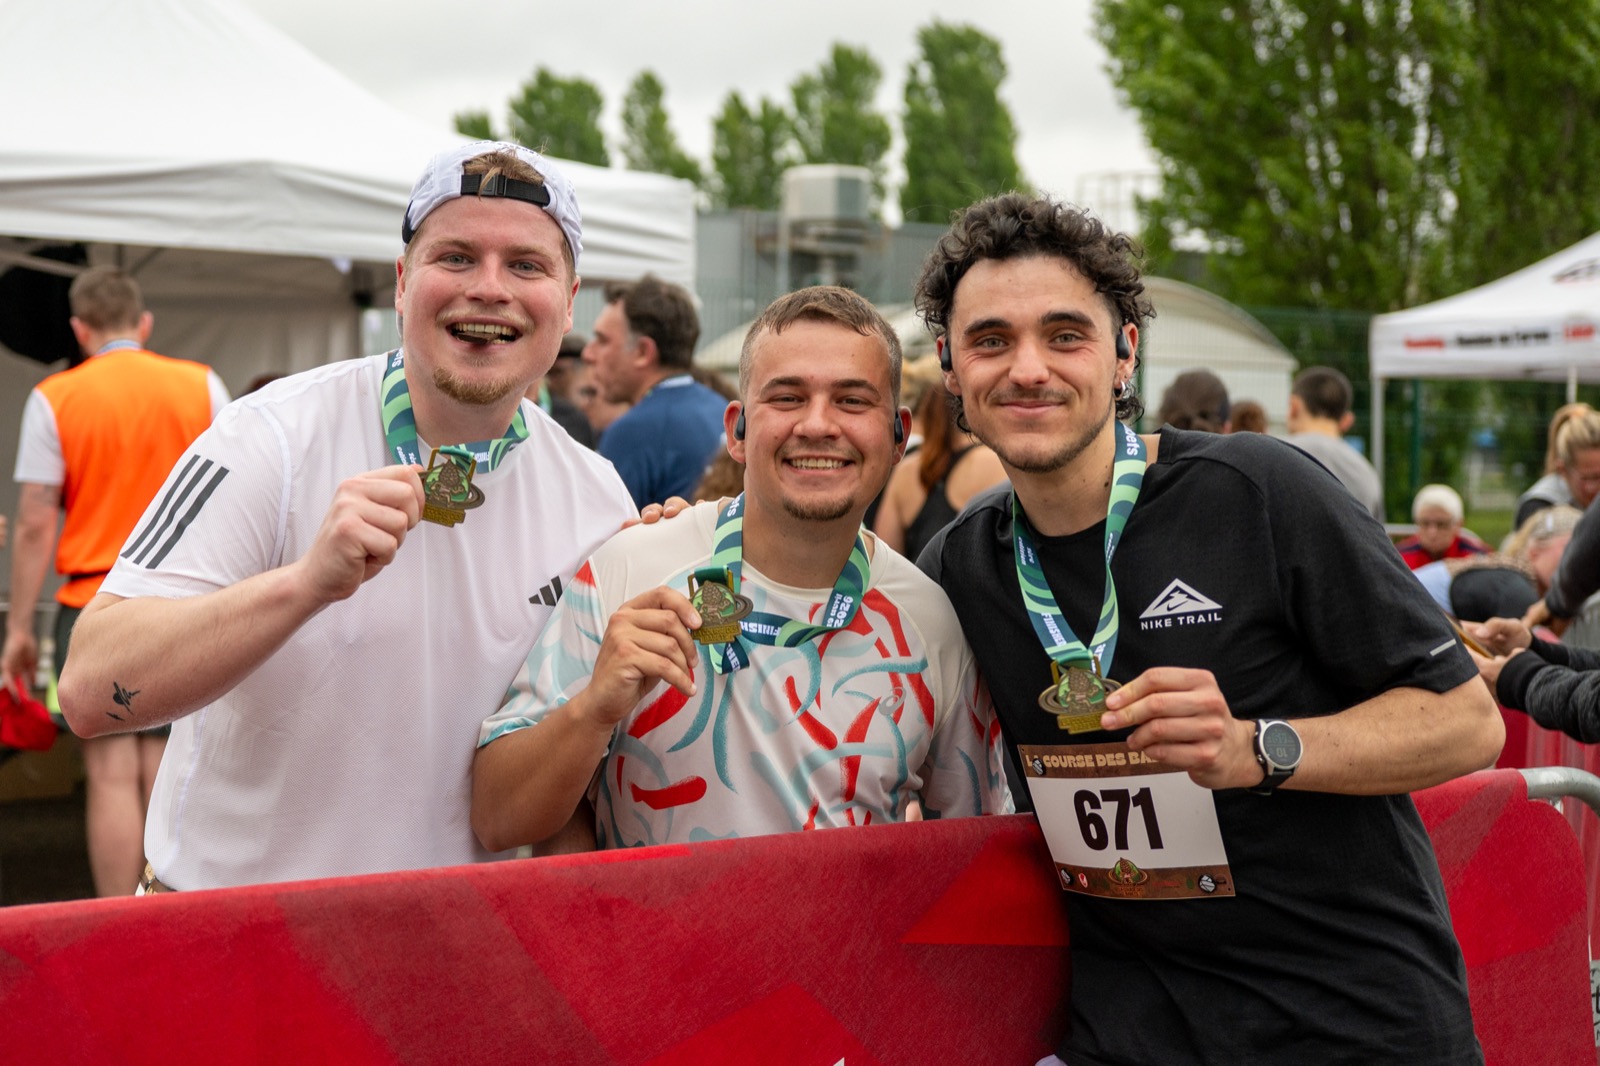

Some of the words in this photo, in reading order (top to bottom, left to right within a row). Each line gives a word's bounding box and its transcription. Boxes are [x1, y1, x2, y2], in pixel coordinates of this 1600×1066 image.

[833, 595, 854, 628] 2026
[738, 620, 781, 637] FINISH
[1140, 618, 1172, 631] NIKE
[1177, 612, 1222, 626] TRAIL
[1025, 754, 1040, 767] L
[1042, 754, 1095, 768] COURSE
[1095, 752, 1127, 767] DES
[1128, 750, 1159, 765] BA
[1073, 786, 1164, 851] 671
